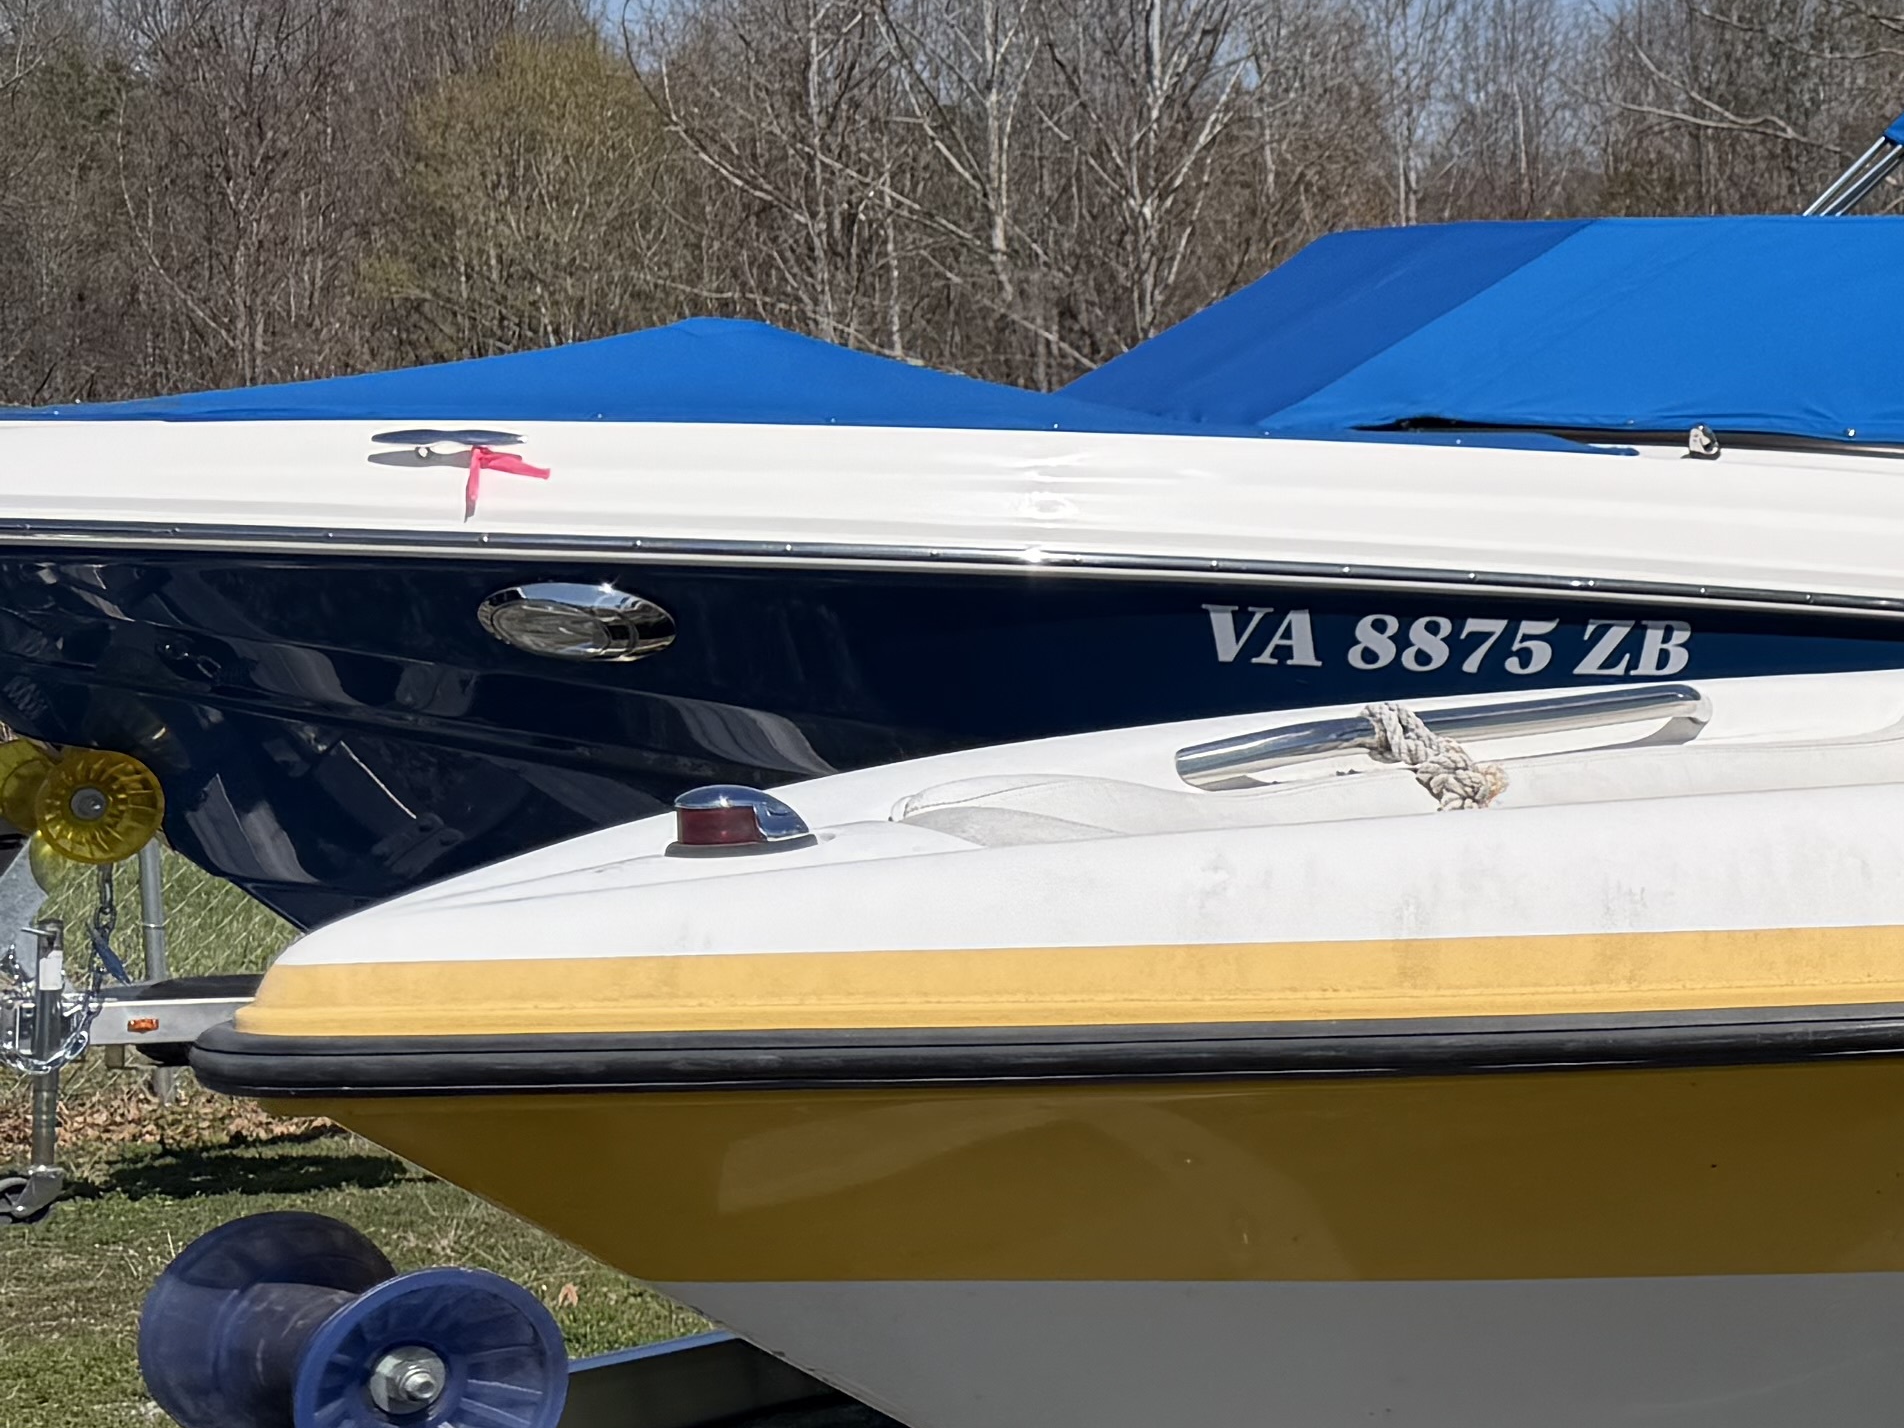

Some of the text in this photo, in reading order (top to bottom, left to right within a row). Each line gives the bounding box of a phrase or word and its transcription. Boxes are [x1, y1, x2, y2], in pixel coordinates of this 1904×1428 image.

[1201, 604, 1692, 676] VA 8875 ZB
